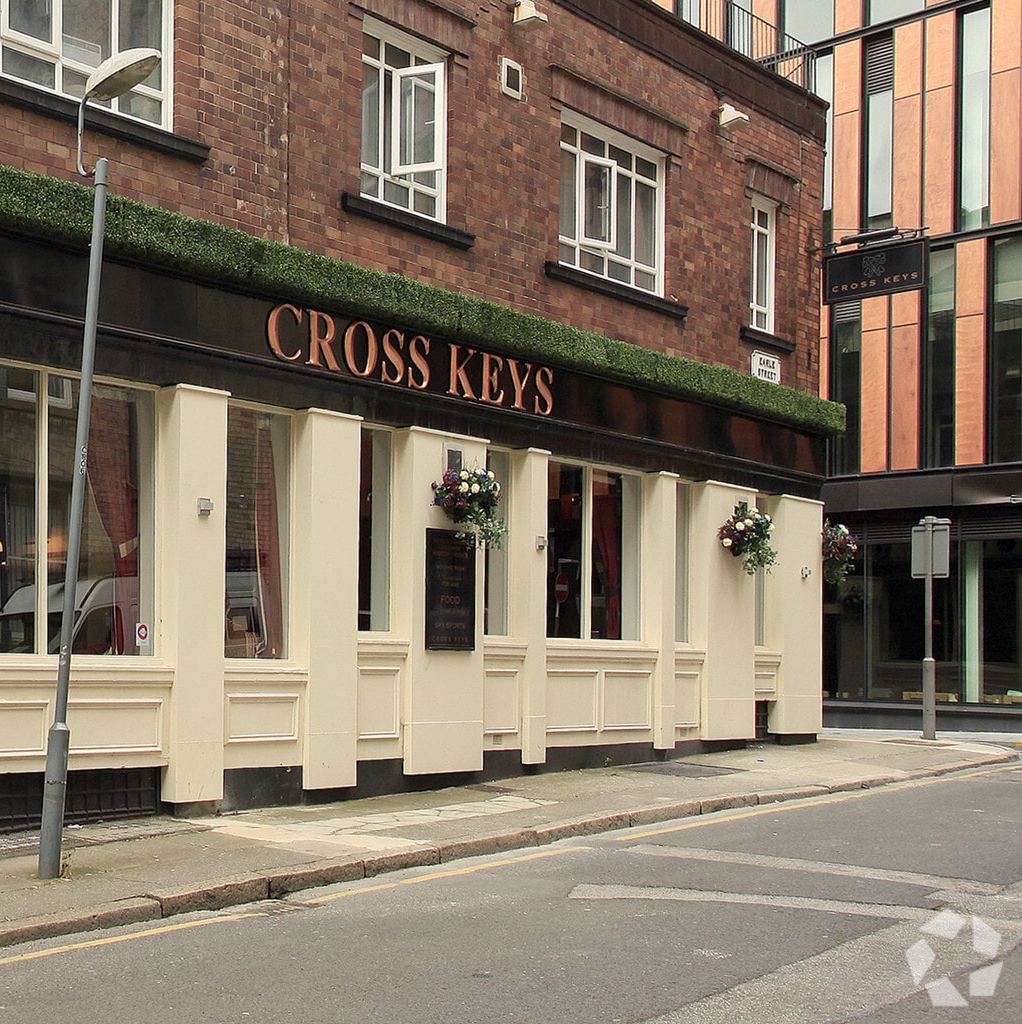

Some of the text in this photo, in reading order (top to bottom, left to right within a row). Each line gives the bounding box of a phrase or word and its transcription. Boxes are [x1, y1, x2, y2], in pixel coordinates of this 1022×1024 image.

[832, 271, 918, 293] CROSS KEYS
[267, 303, 554, 416] CROSS KEYS
[757, 368, 776, 381] STREET
[441, 594, 460, 604] FOOD
